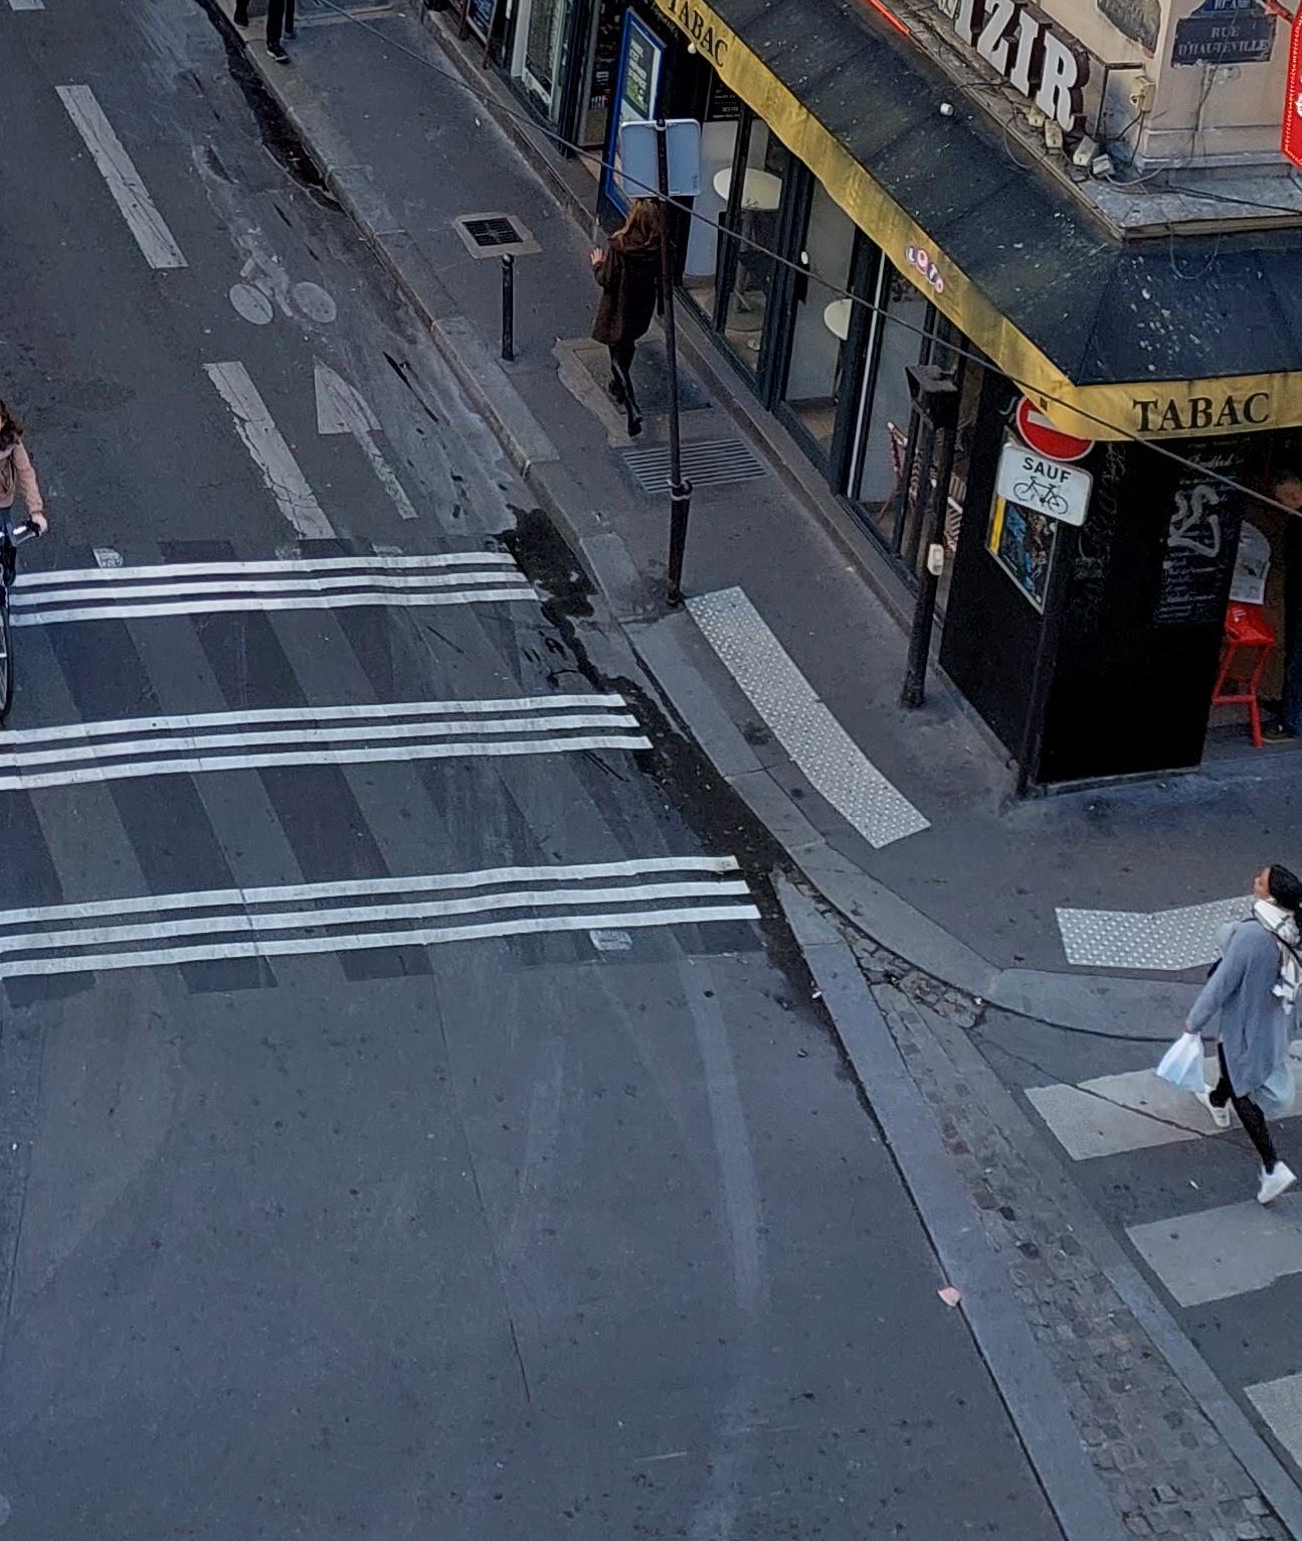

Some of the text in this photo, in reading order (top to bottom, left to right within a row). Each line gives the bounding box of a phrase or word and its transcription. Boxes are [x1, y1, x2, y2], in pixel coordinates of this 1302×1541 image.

[1211, 27, 1239, 39] RUE
[1178, 39, 1269, 56] D'HAUTEVILLE
[906, 246, 944, 293] LOTO
[1132, 392, 1270, 433] TABAC
[1022, 457, 1072, 484] SAUF
